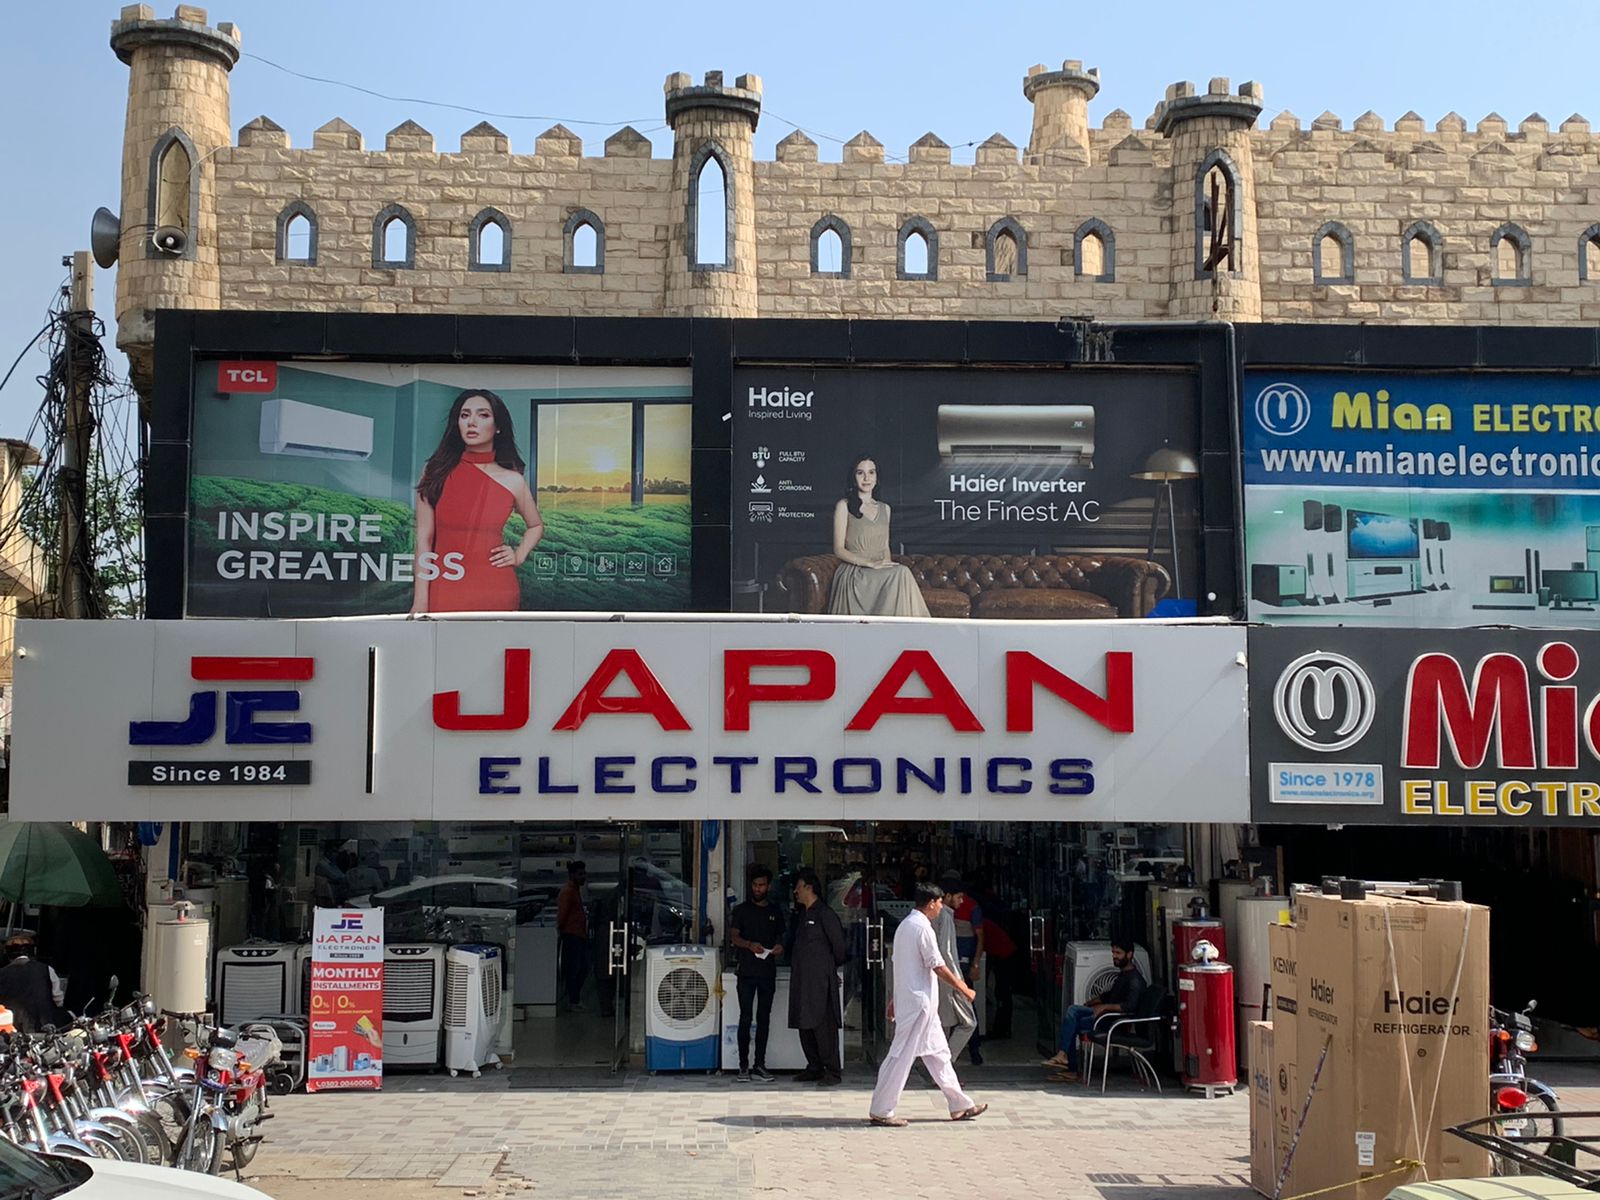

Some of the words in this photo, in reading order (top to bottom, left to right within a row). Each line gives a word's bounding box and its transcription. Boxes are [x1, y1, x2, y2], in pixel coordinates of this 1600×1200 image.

[226, 369, 269, 383] TCL
[748, 385, 814, 408] Haier
[748, 409, 784, 420] Inspired
[785, 409, 812, 421] Living
[1331, 389, 1452, 431] Mian
[752, 452, 770, 460] BTU
[950, 474, 1006, 492] Haier
[1012, 476, 1086, 493] Inverter
[934, 499, 981, 521] The
[987, 500, 1059, 522] Finest
[1063, 500, 1100, 522] AC
[217, 511, 383, 543] INSPIRE
[216, 550, 466, 583] GREATNESS
[432, 648, 1134, 732] JAPAN
[1401, 642, 1600, 769] Mi
[152, 766, 221, 782] Since
[230, 766, 287, 781] 1984
[479, 756, 1094, 795] ELECTRONICS
[1280, 771, 1326, 787] Since
[1334, 772, 1375, 787] 1978
[316, 935, 381, 943] JAPAN
[313, 967, 381, 979] MONTHLY
[313, 982, 379, 990] INSTALLMENTS
[1310, 977, 1334, 1005] Haier
[1384, 990, 1460, 1015] Haier
[1373, 1022, 1471, 1036] REFRIGERATOR
